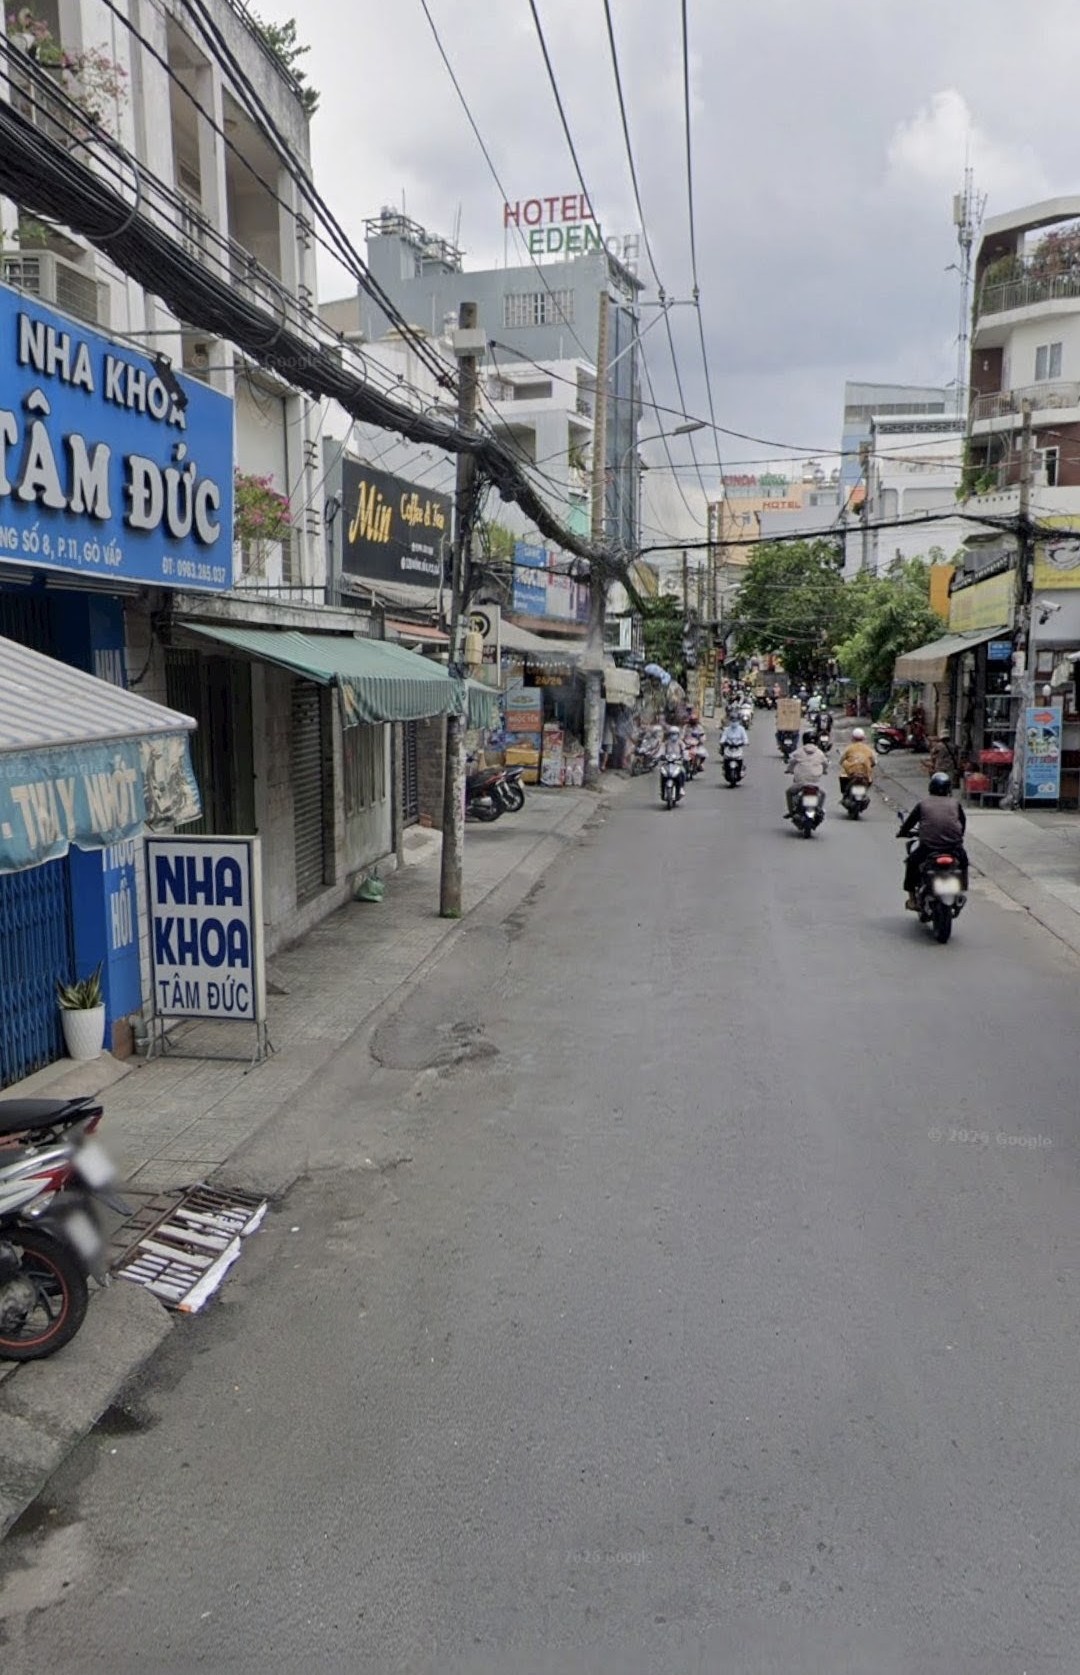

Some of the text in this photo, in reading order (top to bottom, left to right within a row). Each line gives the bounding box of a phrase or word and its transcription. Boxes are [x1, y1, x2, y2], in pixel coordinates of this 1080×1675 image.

[503, 194, 594, 229] HOTEL
[529, 223, 601, 255] EDEN
[19, 313, 95, 392] NHA
[129, 443, 221, 545] ĐỨC
[348, 481, 393, 544] Min
[763, 501, 802, 509] HOTEL
[22, 521, 40, 553] SỐ
[83, 537, 100, 563] GÒ
[103, 537, 123, 567] VẤP
[155, 856, 243, 907] NHA
[154, 916, 249, 969] KHOA
[159, 972, 249, 1013] TÂM ĐỨC
